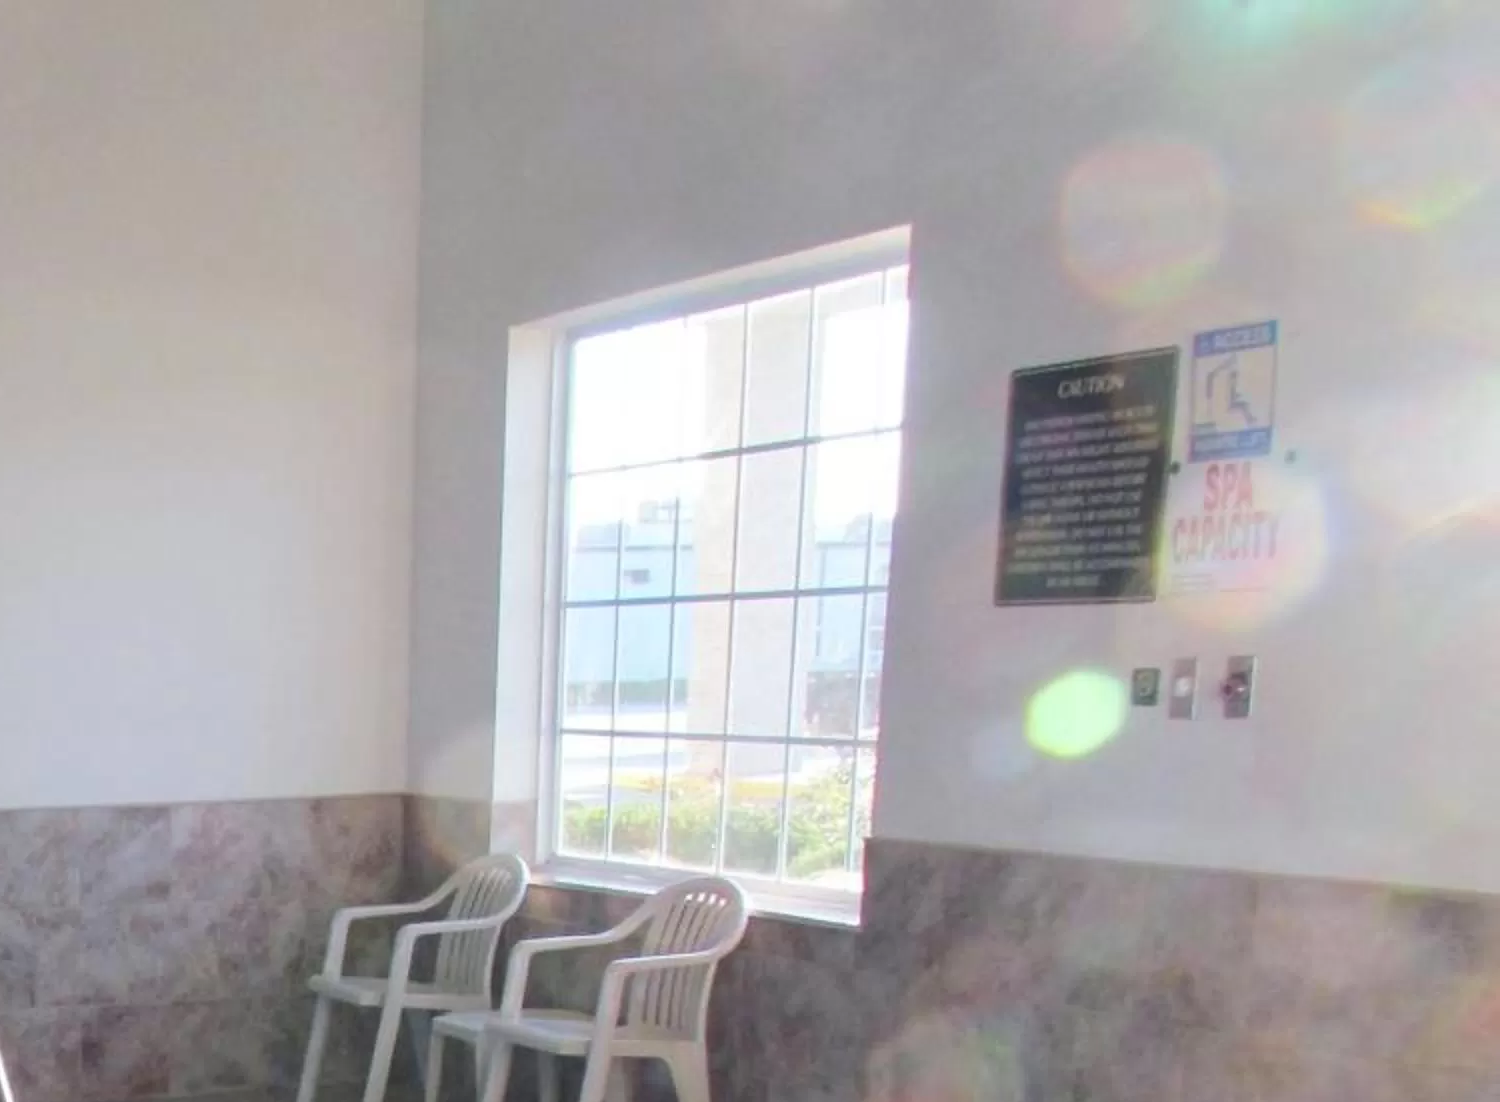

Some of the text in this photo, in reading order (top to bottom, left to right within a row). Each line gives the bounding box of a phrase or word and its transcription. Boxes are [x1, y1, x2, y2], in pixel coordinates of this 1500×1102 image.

[1057, 374, 1125, 399] CAUTION
[1203, 462, 1252, 513] SPA
[1171, 511, 1280, 563] CAPACITY
